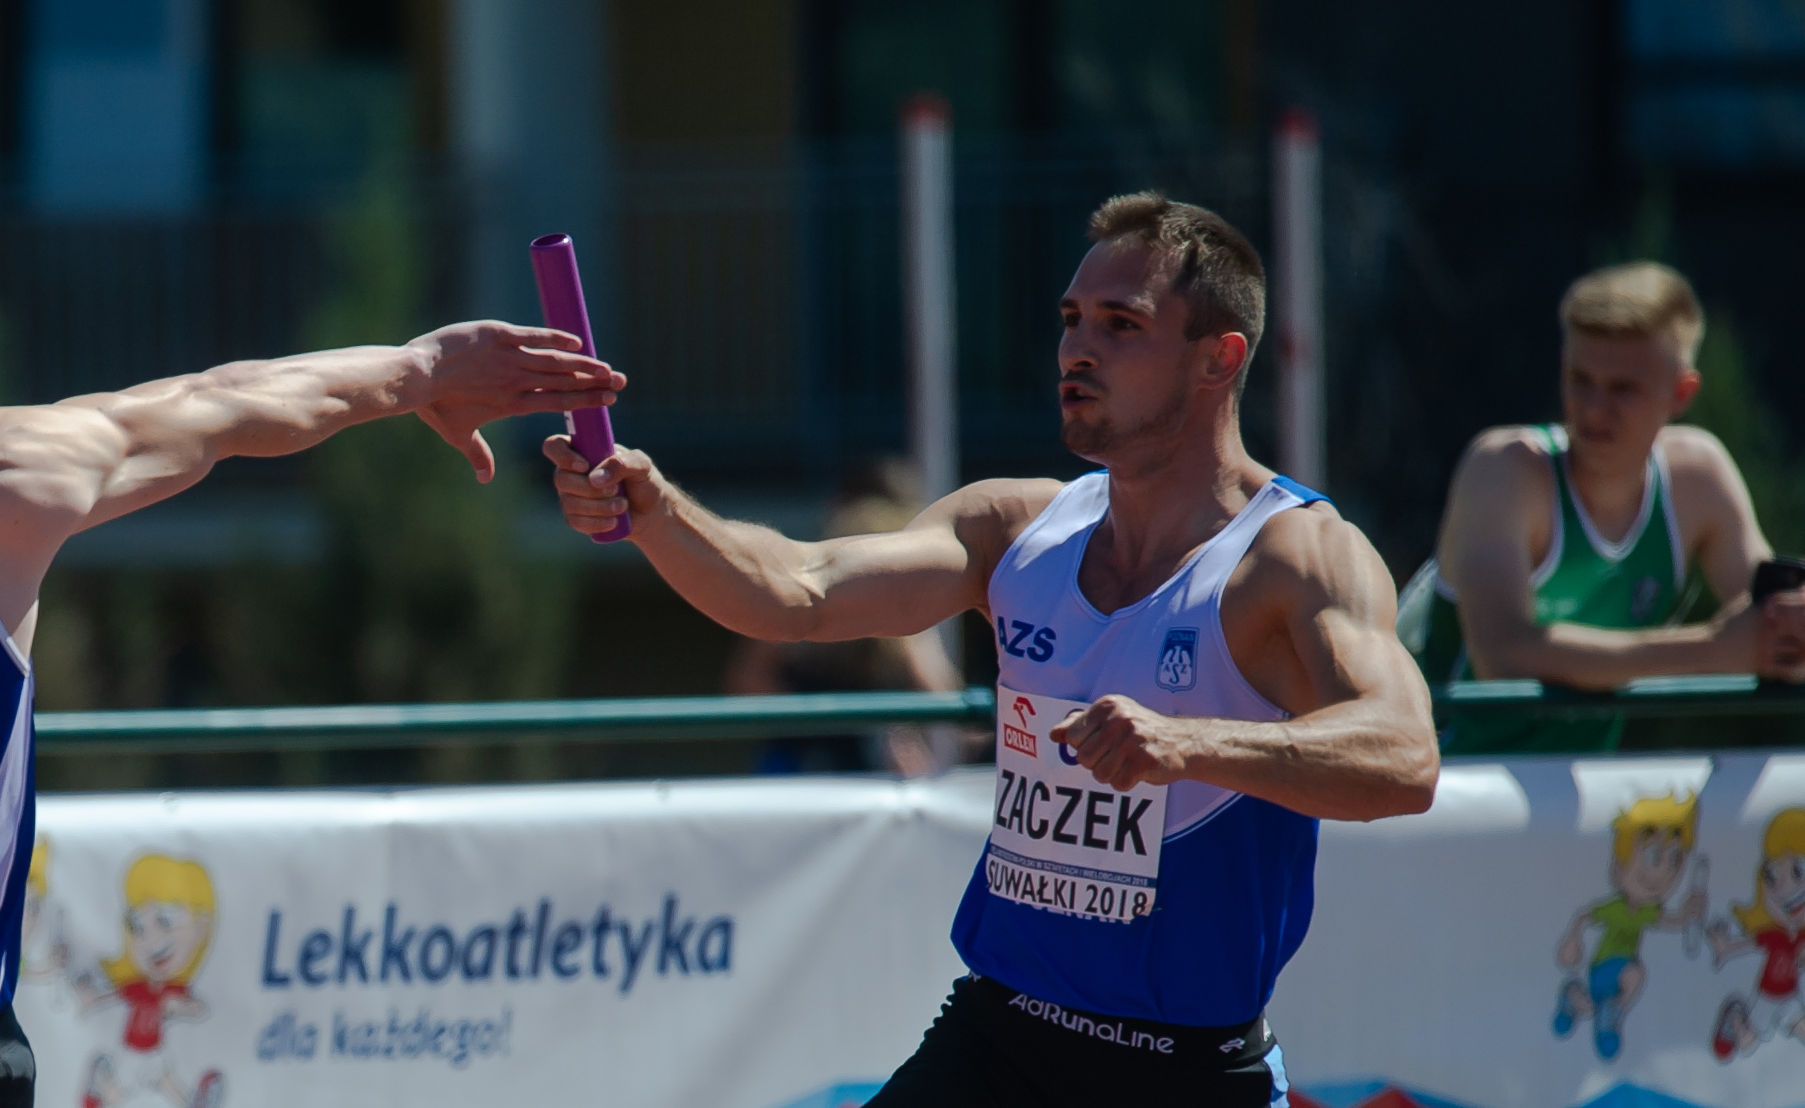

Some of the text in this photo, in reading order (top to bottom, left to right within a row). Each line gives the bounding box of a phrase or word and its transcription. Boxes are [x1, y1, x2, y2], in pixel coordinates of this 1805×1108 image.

[997, 616, 1056, 663] AZS
[1006, 729, 1034, 752] ORLEN
[996, 769, 1153, 856] ZACZEK
[988, 859, 1076, 910] SUWAŁKI
[1085, 884, 1148, 918] 2018
[261, 890, 736, 997] Lekkoatletyka
[255, 1009, 318, 1061] dla
